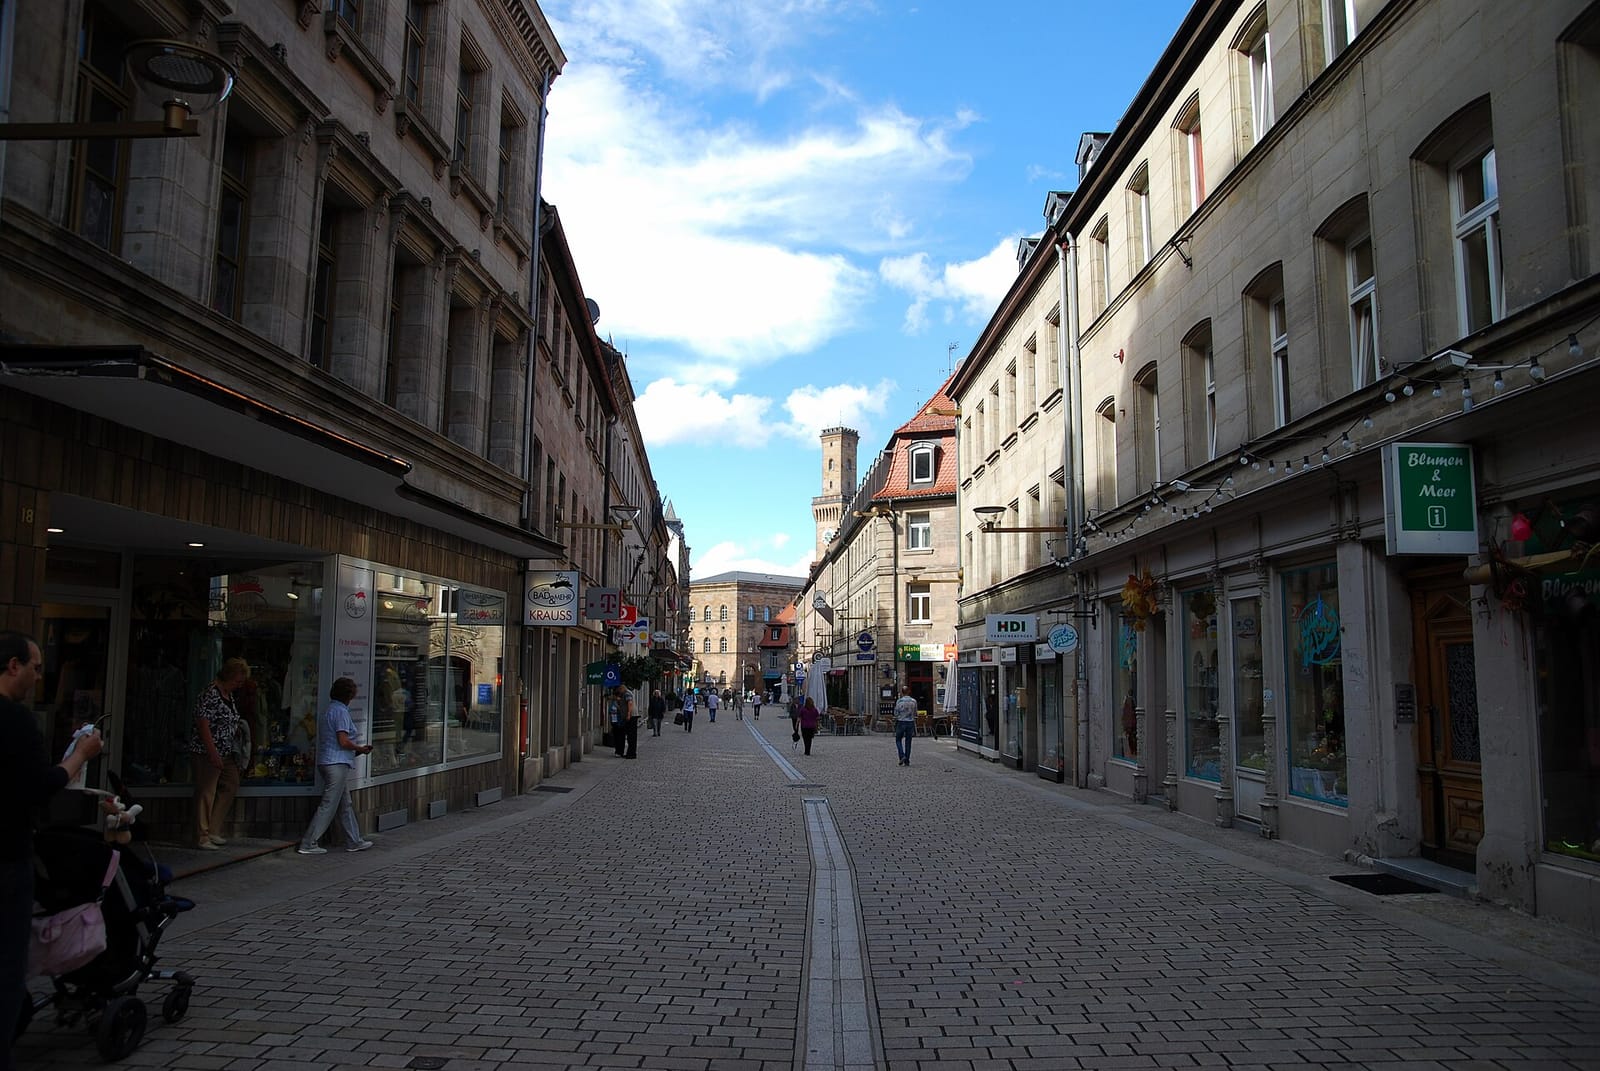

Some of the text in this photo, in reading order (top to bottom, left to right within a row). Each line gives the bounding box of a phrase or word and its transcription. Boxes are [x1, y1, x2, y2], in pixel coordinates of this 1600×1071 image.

[1408, 452, 1464, 467] Blumen
[1432, 469, 1441, 482] &
[1419, 484, 1456, 497] Meer
[22, 507, 33, 523] 18
[533, 591, 550, 600] BAD
[529, 610, 572, 621] KRAUSS
[997, 621, 1026, 632] HDI
